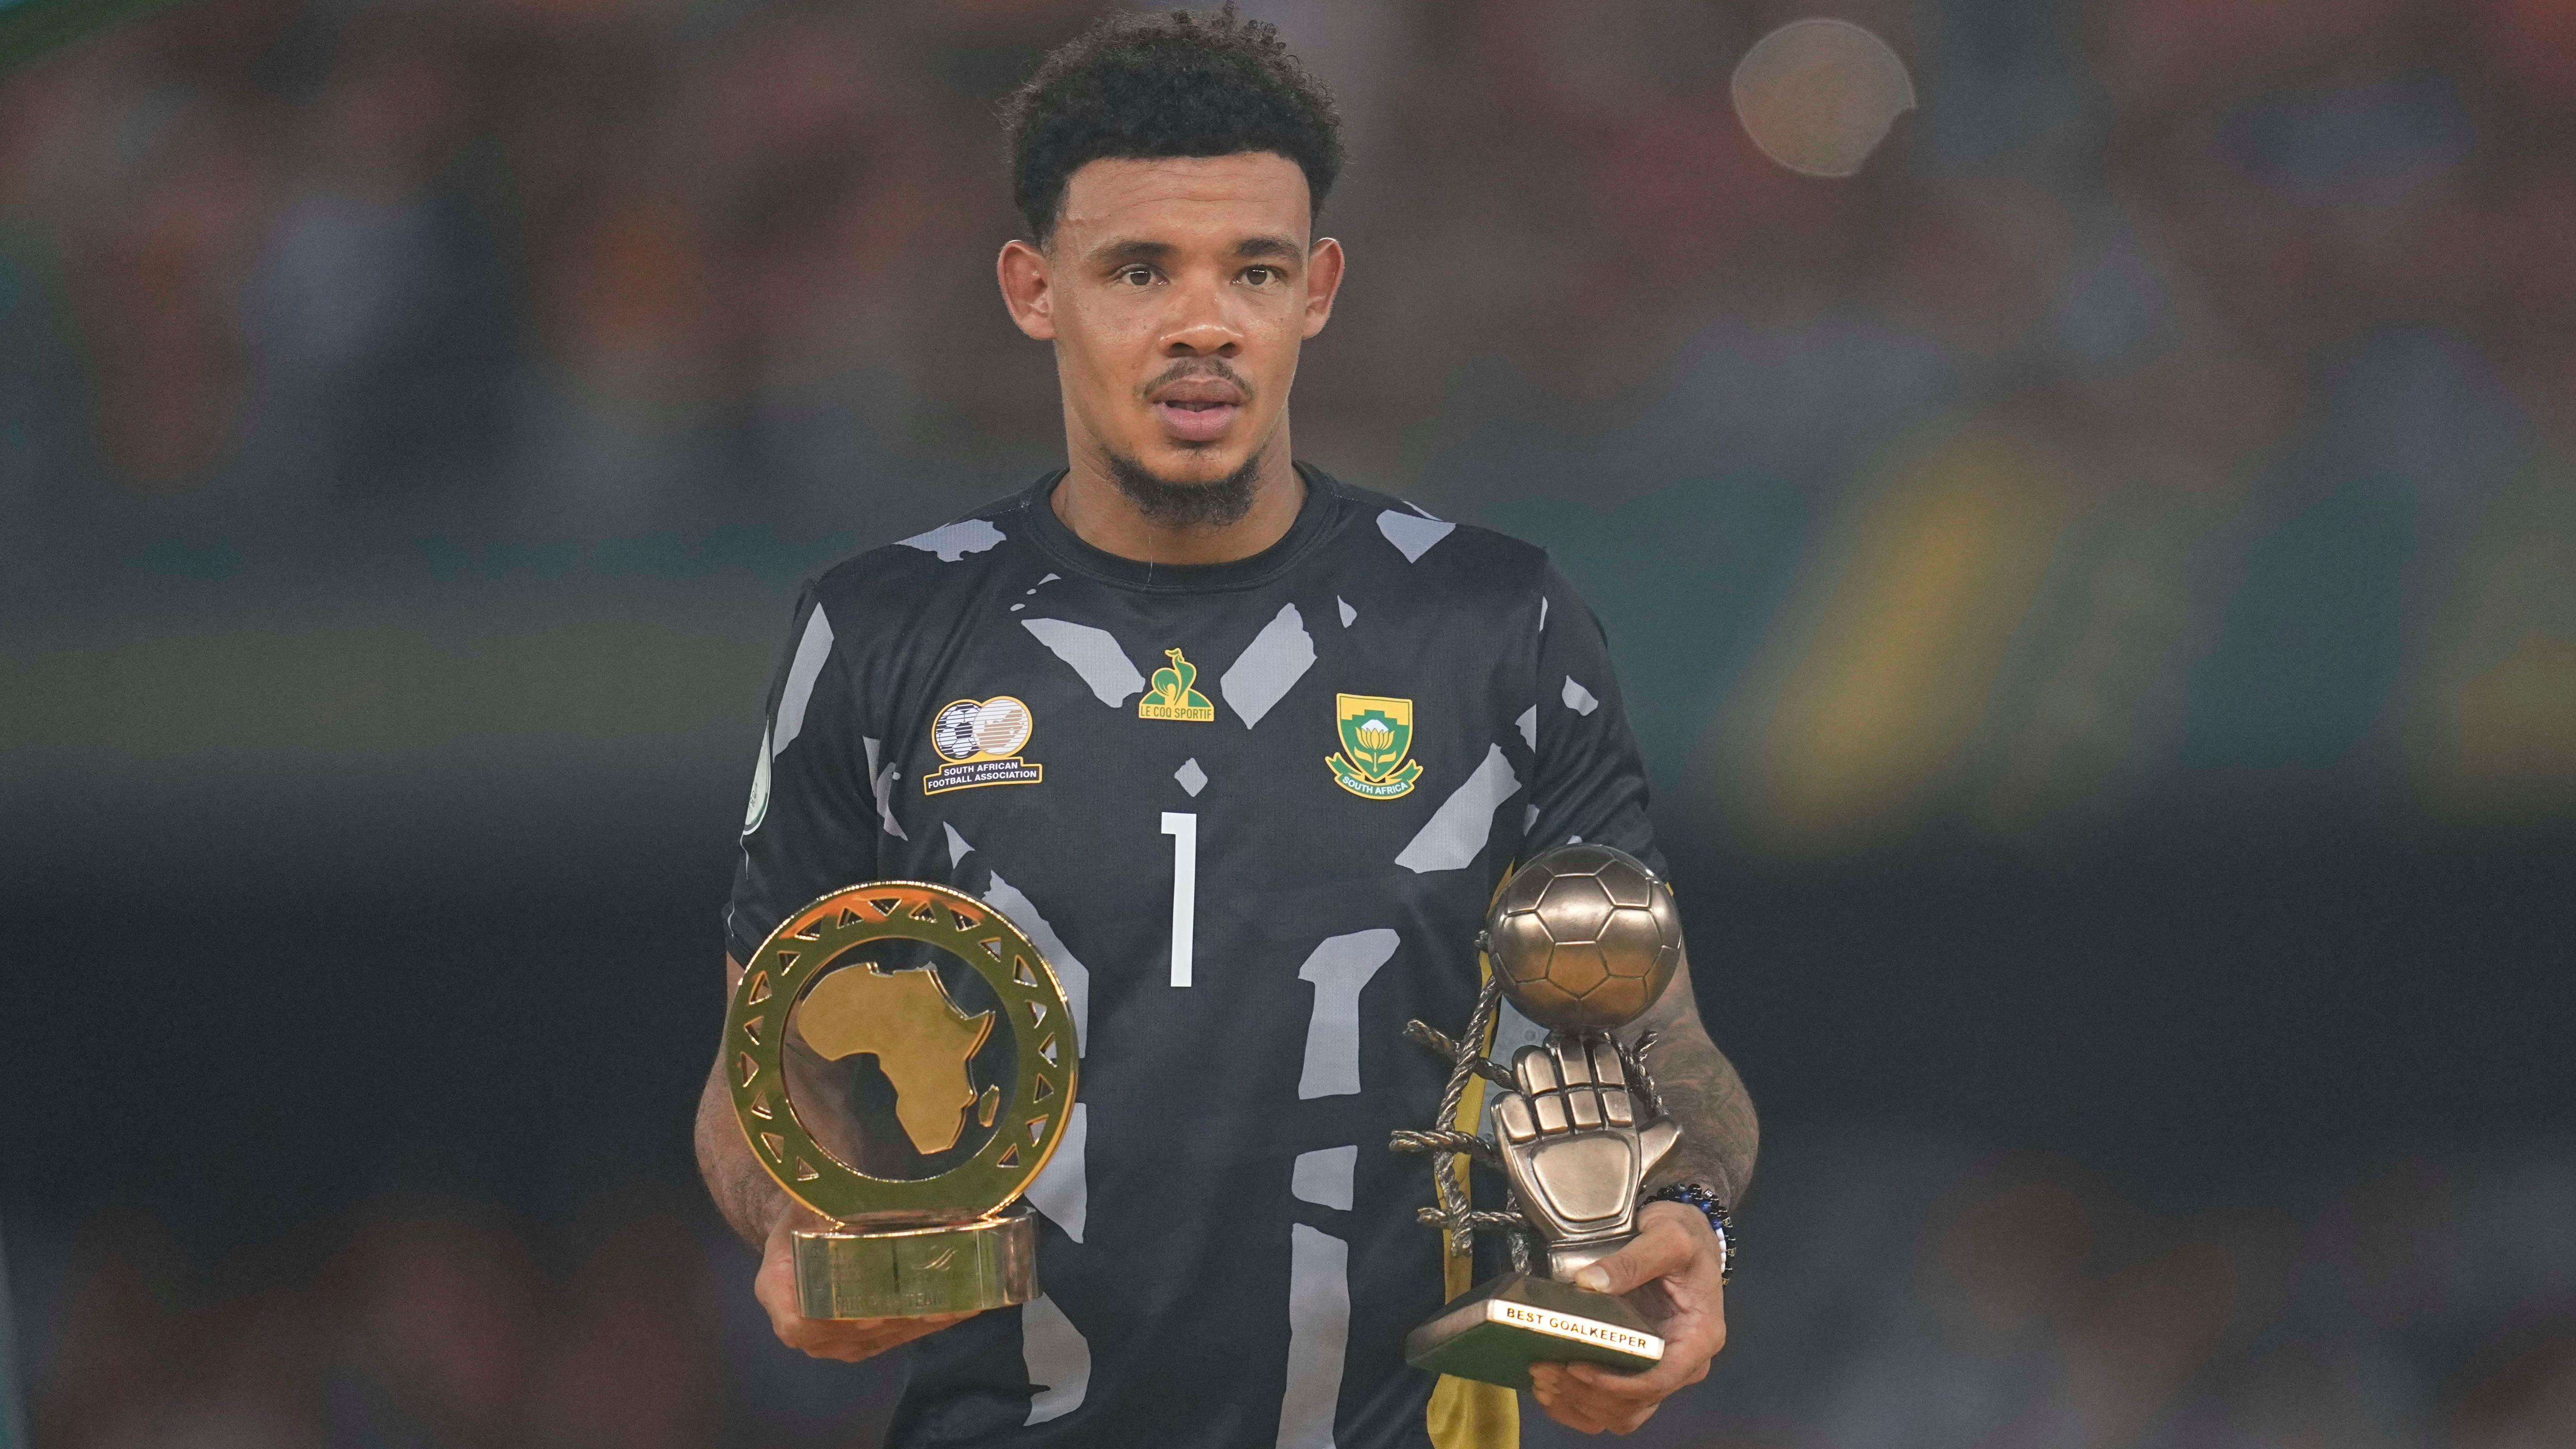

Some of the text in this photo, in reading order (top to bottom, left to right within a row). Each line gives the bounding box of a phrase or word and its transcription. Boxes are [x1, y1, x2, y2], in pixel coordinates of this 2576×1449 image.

[1140, 706, 1212, 719] LE COQ SPORTIF
[944, 762, 1018, 776] SOUTH AFRICAN
[928, 770, 1036, 789] FOOTBALL ASSOCIATION
[1342, 776, 1408, 795] SOUTH AFRICA
[1161, 812, 1197, 987] 1
[1507, 1308, 1646, 1349] BEST GOALKEEPER
